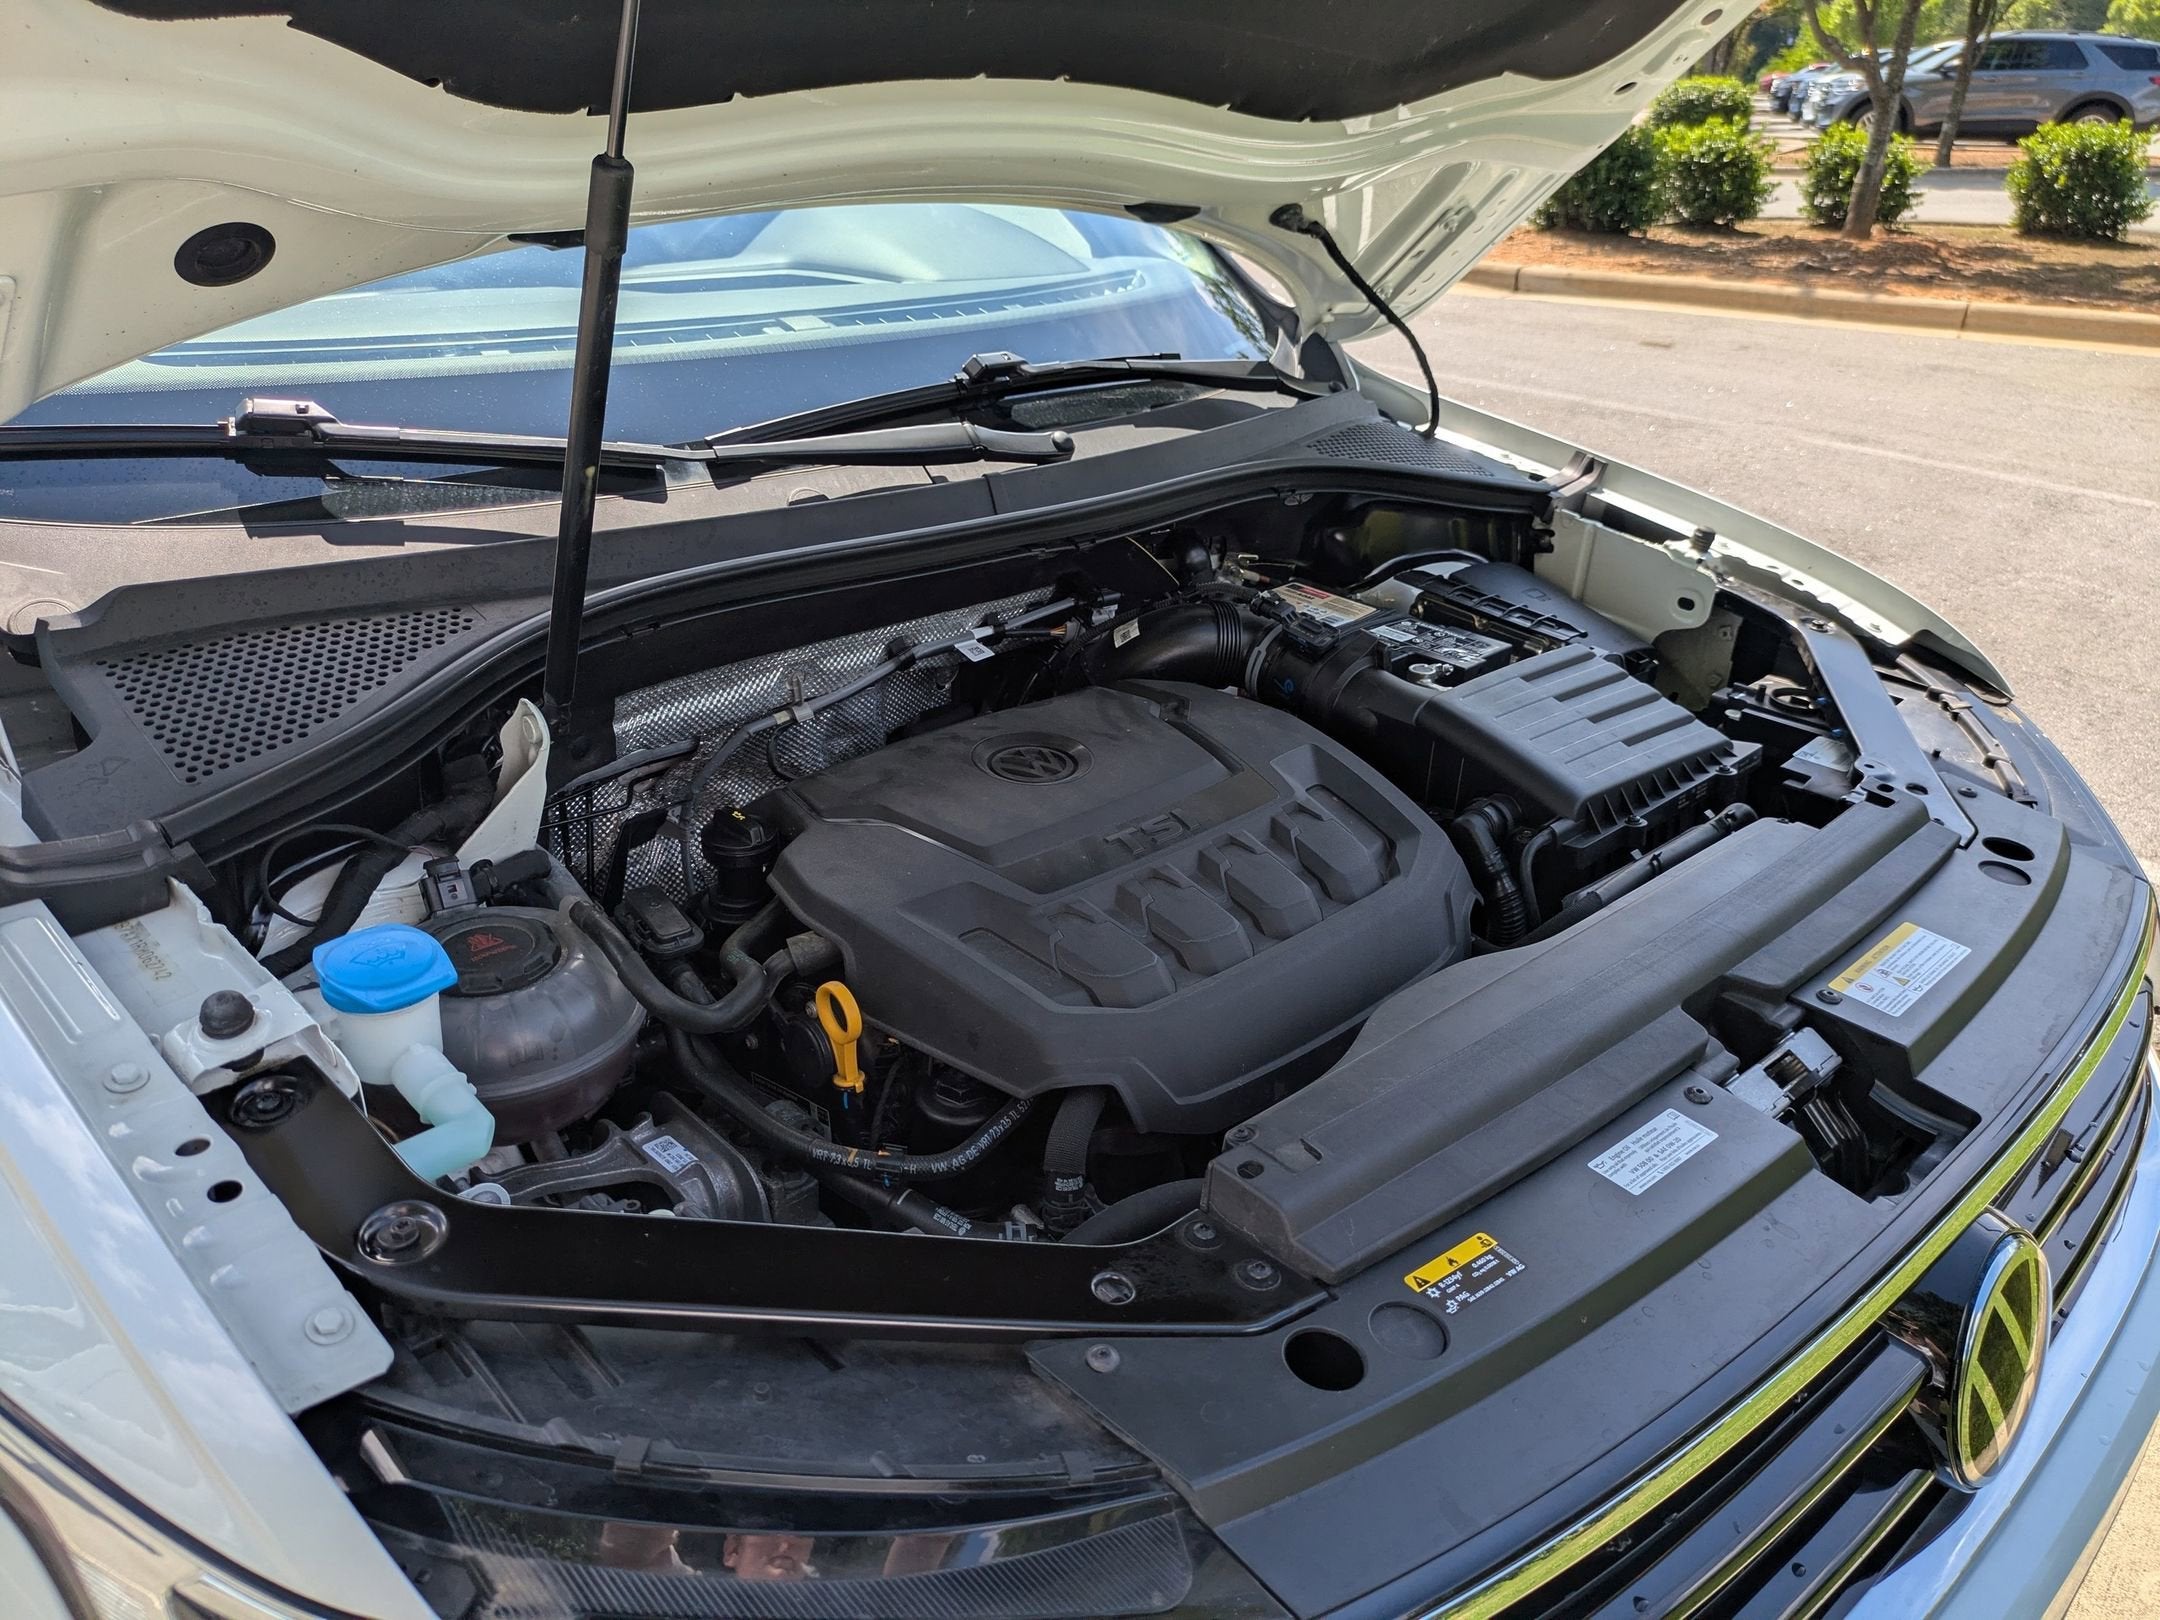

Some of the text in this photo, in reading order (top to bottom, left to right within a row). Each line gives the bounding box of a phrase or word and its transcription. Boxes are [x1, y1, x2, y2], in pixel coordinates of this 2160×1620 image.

[1103, 807, 1200, 855] TSI
[931, 1162, 948, 1174] VW
[951, 1155, 967, 1171] AG
[1505, 1269, 1517, 1277] VW
[1455, 1291, 1471, 1302] PAG
